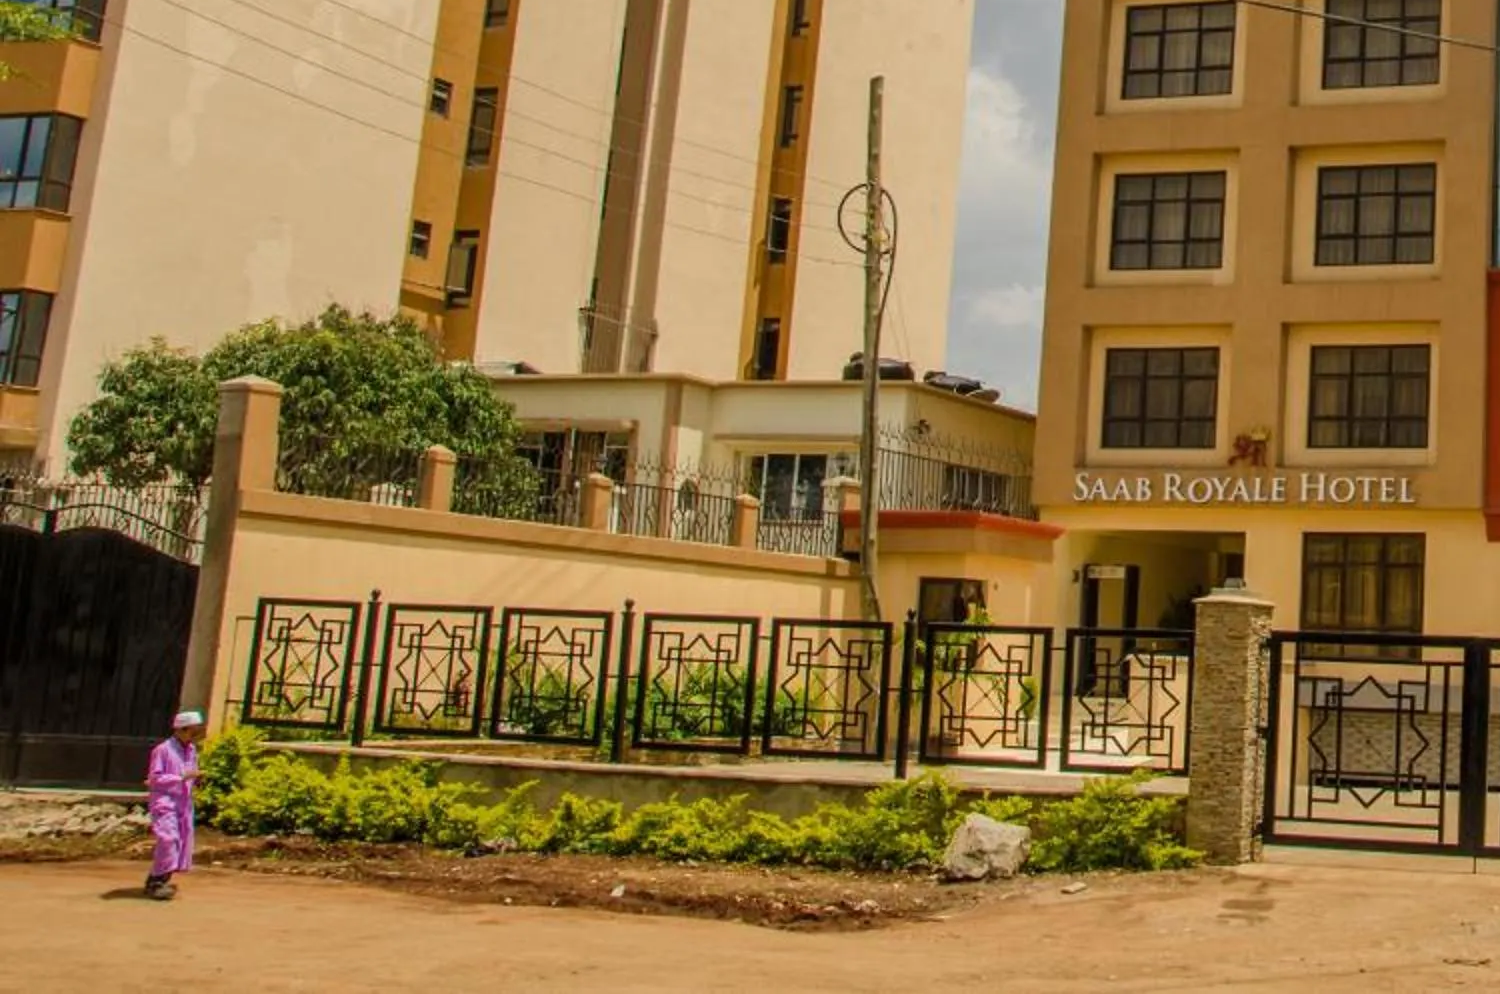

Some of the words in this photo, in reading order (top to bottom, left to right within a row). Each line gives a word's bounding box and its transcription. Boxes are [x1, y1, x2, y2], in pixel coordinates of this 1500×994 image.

[1073, 472, 1152, 502] SAAB
[1163, 472, 1286, 503] ROYALE
[1301, 472, 1416, 503] HOTEL
